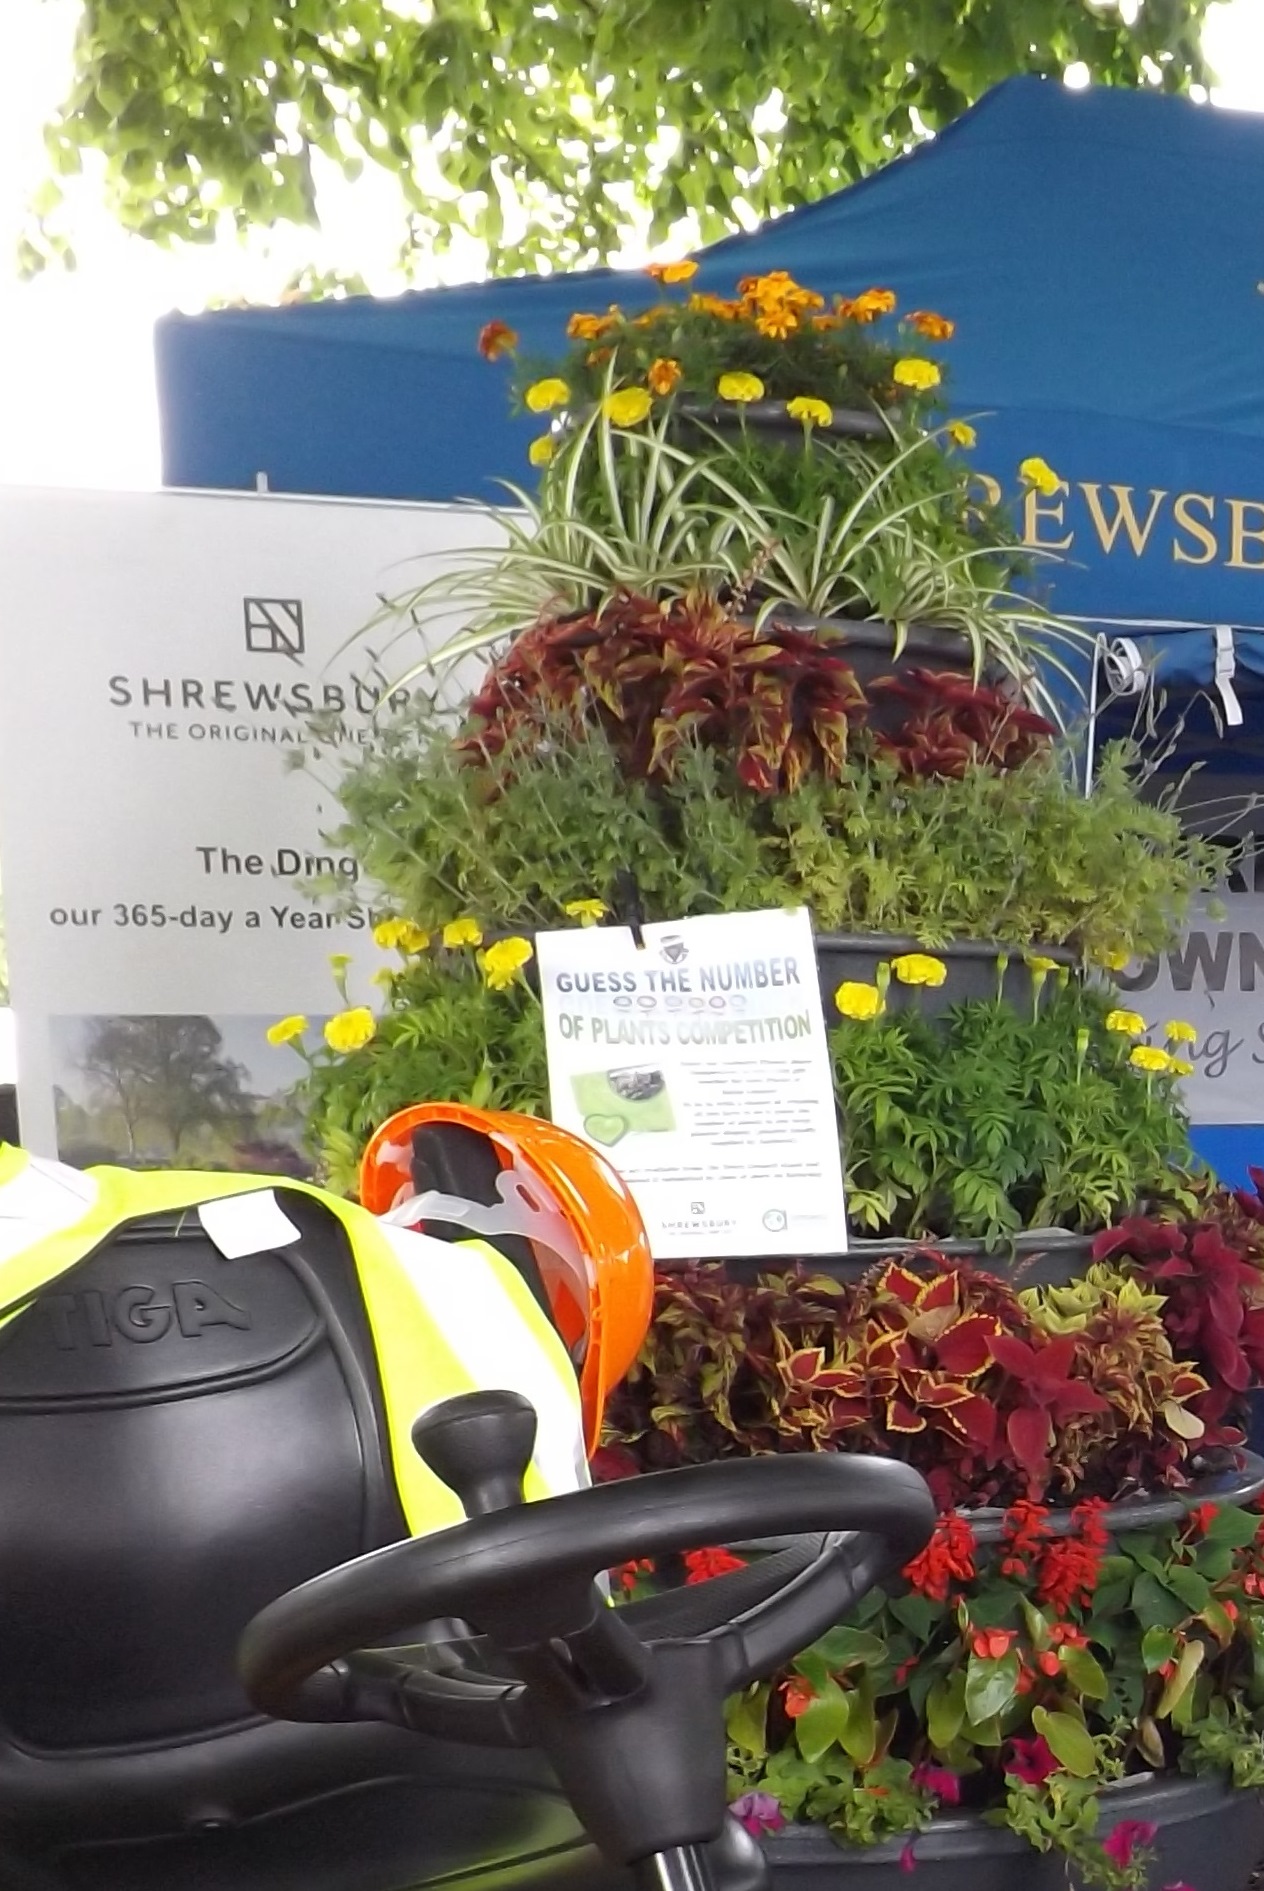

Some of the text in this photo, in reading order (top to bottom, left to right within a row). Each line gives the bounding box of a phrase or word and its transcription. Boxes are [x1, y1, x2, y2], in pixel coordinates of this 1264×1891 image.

[129, 721, 179, 739] THE
[188, 723, 307, 744] ORIGINAL
[196, 847, 263, 875] The
[49, 907, 102, 927] our
[113, 903, 233, 934] 365-day
[245, 911, 261, 928] a
[270, 905, 336, 929] Year
[555, 956, 802, 993] GUESS THE NUMBER
[559, 1008, 812, 1045] OF PLANTS COMPETITION
